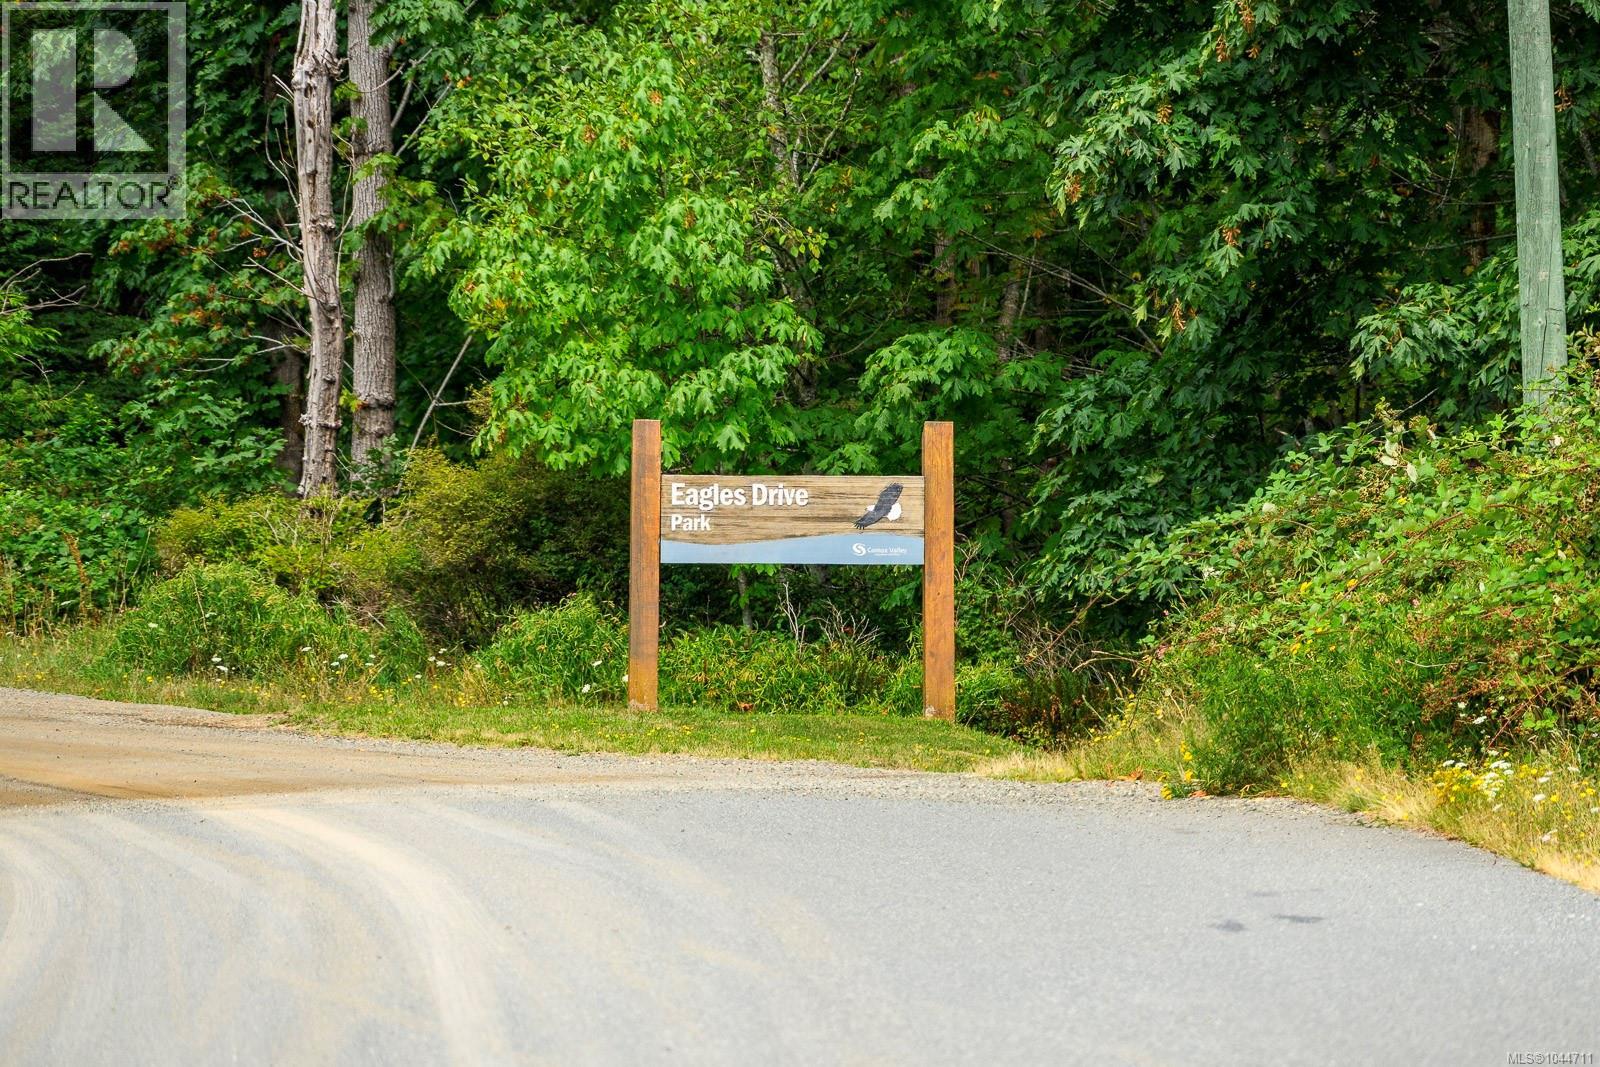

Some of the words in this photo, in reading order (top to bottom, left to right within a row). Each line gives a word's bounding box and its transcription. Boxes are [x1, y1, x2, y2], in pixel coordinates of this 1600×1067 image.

[671, 482, 746, 511] Eagles
[752, 483, 809, 506] Drive
[671, 513, 711, 531] Park
